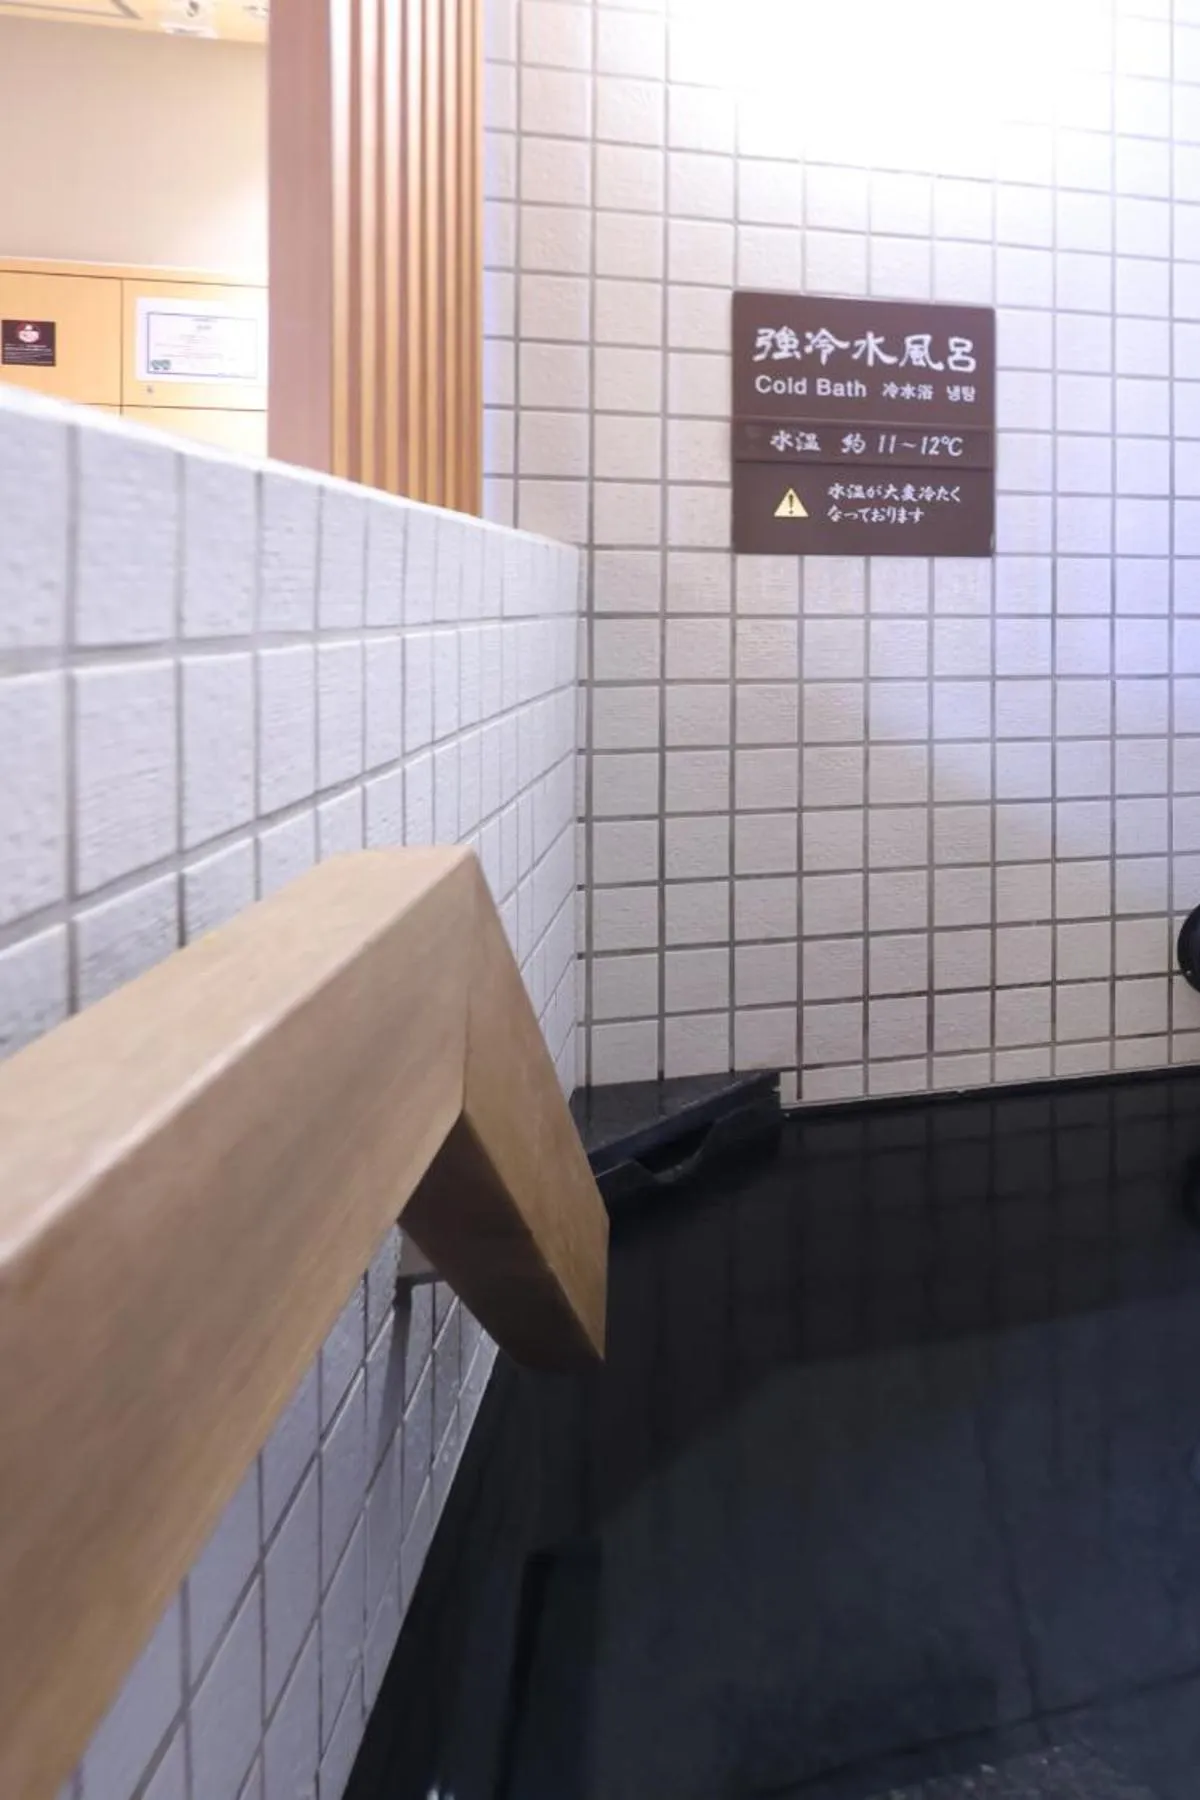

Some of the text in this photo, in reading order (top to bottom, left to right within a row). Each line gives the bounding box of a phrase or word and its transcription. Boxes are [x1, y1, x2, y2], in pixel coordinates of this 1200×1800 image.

[753, 326, 977, 373] 強冷水風呂
[754, 375, 976, 402] Cold Bath 冷水浴 냉탕
[770, 430, 821, 451] 水温
[841, 433, 866, 453] 約
[827, 483, 961, 502] 水温が大変冷たく
[827, 505, 924, 524] なっております
